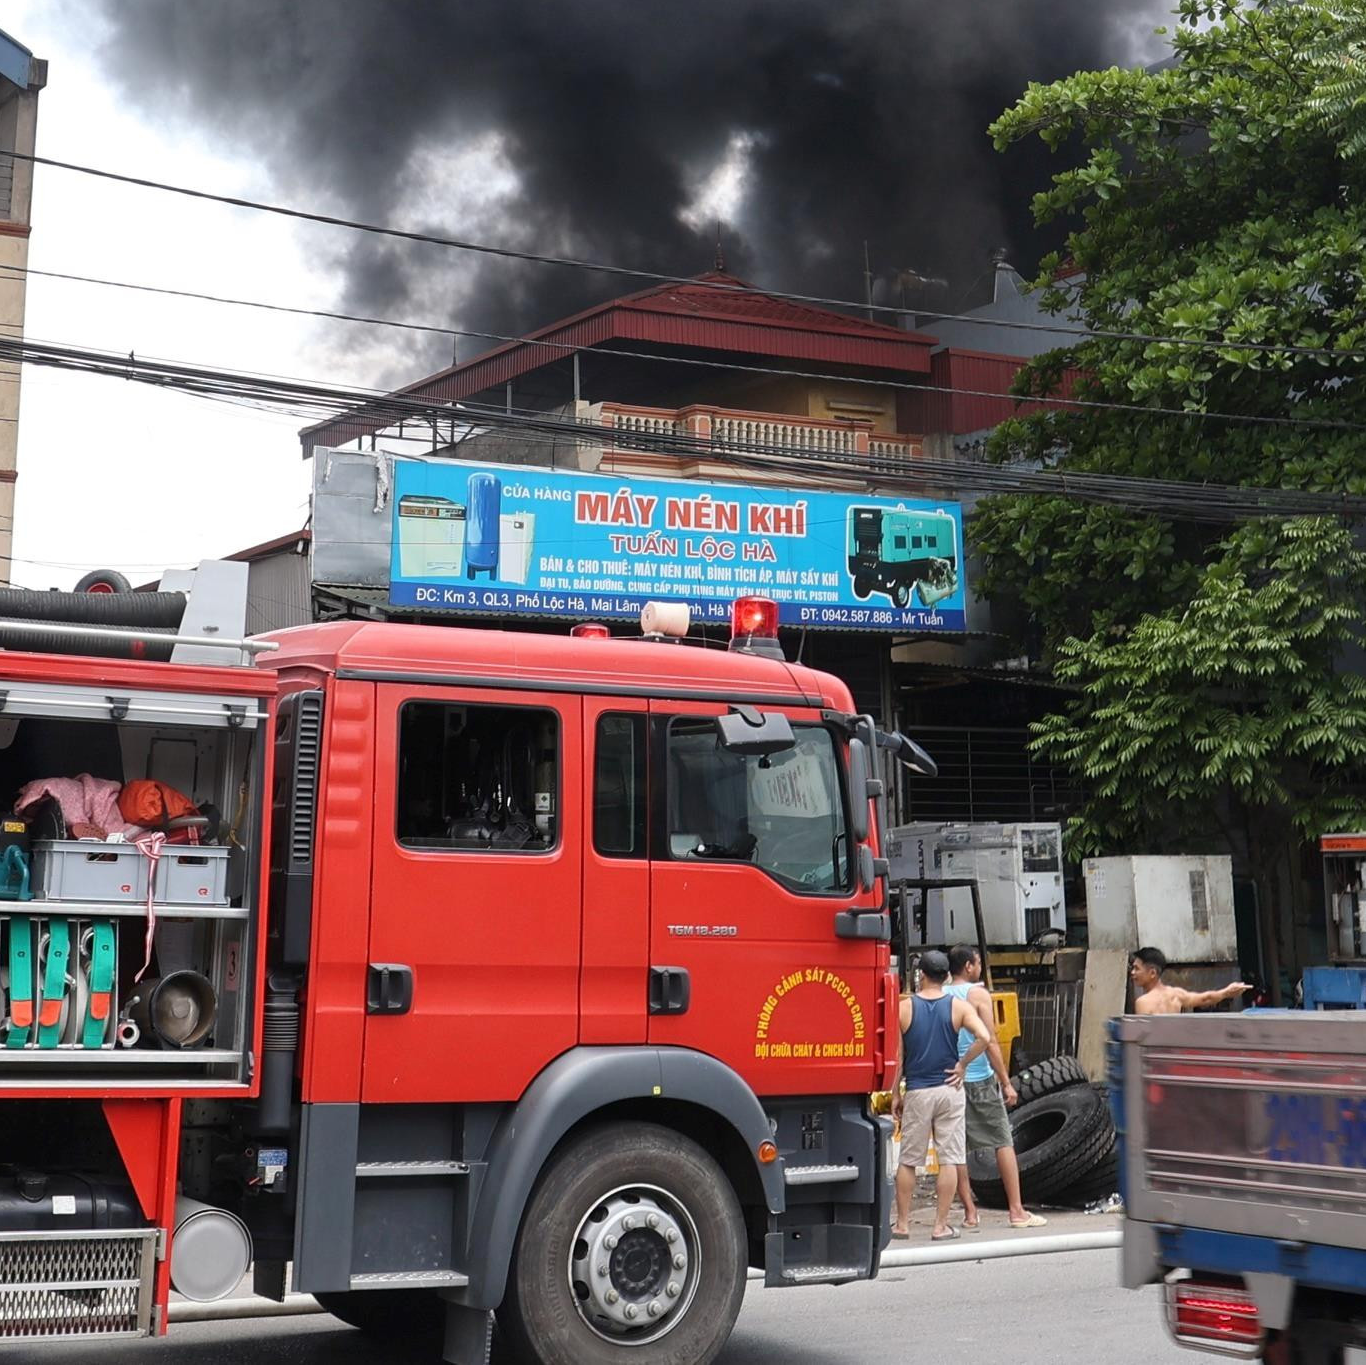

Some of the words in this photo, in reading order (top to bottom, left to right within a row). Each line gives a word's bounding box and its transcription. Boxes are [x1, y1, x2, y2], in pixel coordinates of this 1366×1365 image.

[503, 483, 530, 498] CỬA
[534, 486, 572, 501] HÀNG
[576, 488, 656, 526] MÁY
[667, 495, 740, 533] NÉN
[749, 501, 807, 537] KHÍ
[610, 531, 677, 556] TUẤN
[686, 537, 734, 561] LỘC
[743, 540, 777, 562] HÀ
[540, 554, 563, 572] BÁN
[566, 558, 575, 573] &
[577, 559, 599, 574] CHO
[601, 559, 632, 576] THUÊ:
[634, 560, 657, 577] MÁY
[660, 562, 682, 578] NÉN
[684, 563, 705, 581] KHÍ,
[707, 564, 731, 581] BÌNH
[734, 565, 756, 582] TÍCH
[758, 566, 774, 584] ÁP,
[776, 568, 798, 585] MÁY
[800, 567, 820, 585] SẤY
[821, 570, 839, 586] KHÍ
[416, 588, 440, 602] ĐC:
[444, 589, 465, 604] Km
[468, 591, 479, 606] 3,
[483, 592, 512, 608] QL3,
[516, 593, 540, 608] Phố
[543, 596, 565, 611] Lộc
[568, 597, 587, 612] Hà,
[591, 598, 613, 612] Mai
[709, 604, 724, 616] Hà
[628, 581, 652, 593] CUNG
[716, 584, 735, 597] MÁY
[809, 590, 839, 602] PISTON
[801, 608, 819, 621] ĐT:
[821, 608, 893, 623] 0942.587.886
[902, 612, 916, 624] Mr
[756, 995, 778, 1039] PHÒNG
[775, 970, 803, 997] CẢNH
[805, 966, 825, 982] SÁT
[825, 972, 851, 998] PCCC
[850, 1004, 865, 1039] CNCH
[755, 1041, 769, 1060] ĐỘI
[770, 1041, 792, 1057] CHỮA
[793, 1041, 814, 1057] CHÁY
[815, 1043, 821, 1057] &
[844, 1037, 854, 1057] SỐ
[855, 1043, 864, 1057] 01
